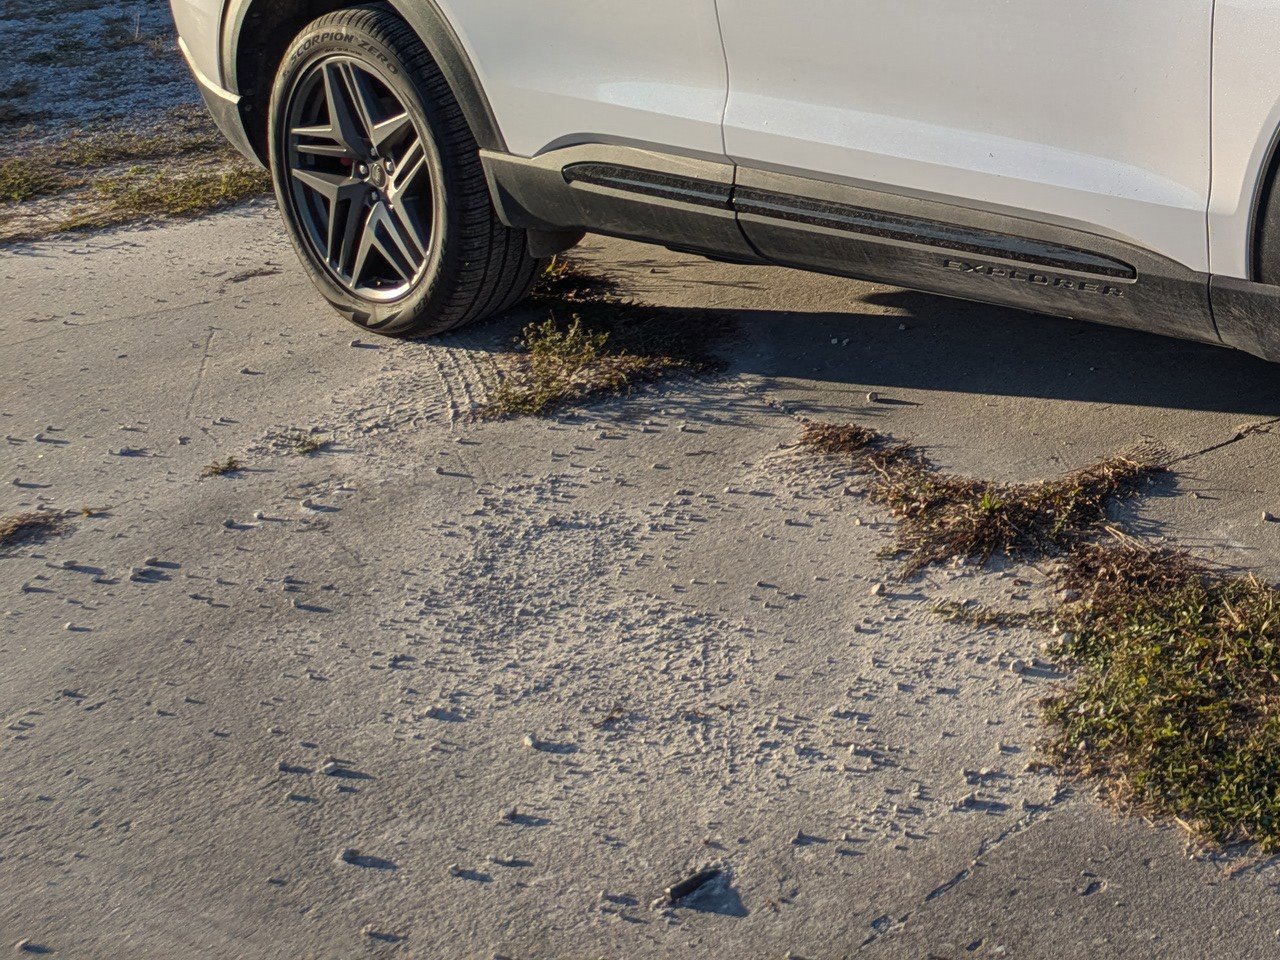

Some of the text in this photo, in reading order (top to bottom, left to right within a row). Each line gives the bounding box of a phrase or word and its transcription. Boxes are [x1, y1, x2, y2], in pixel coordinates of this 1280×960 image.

[290, 31, 399, 75] SCORPION ZERO
[943, 259, 1125, 298] EXPLORER
